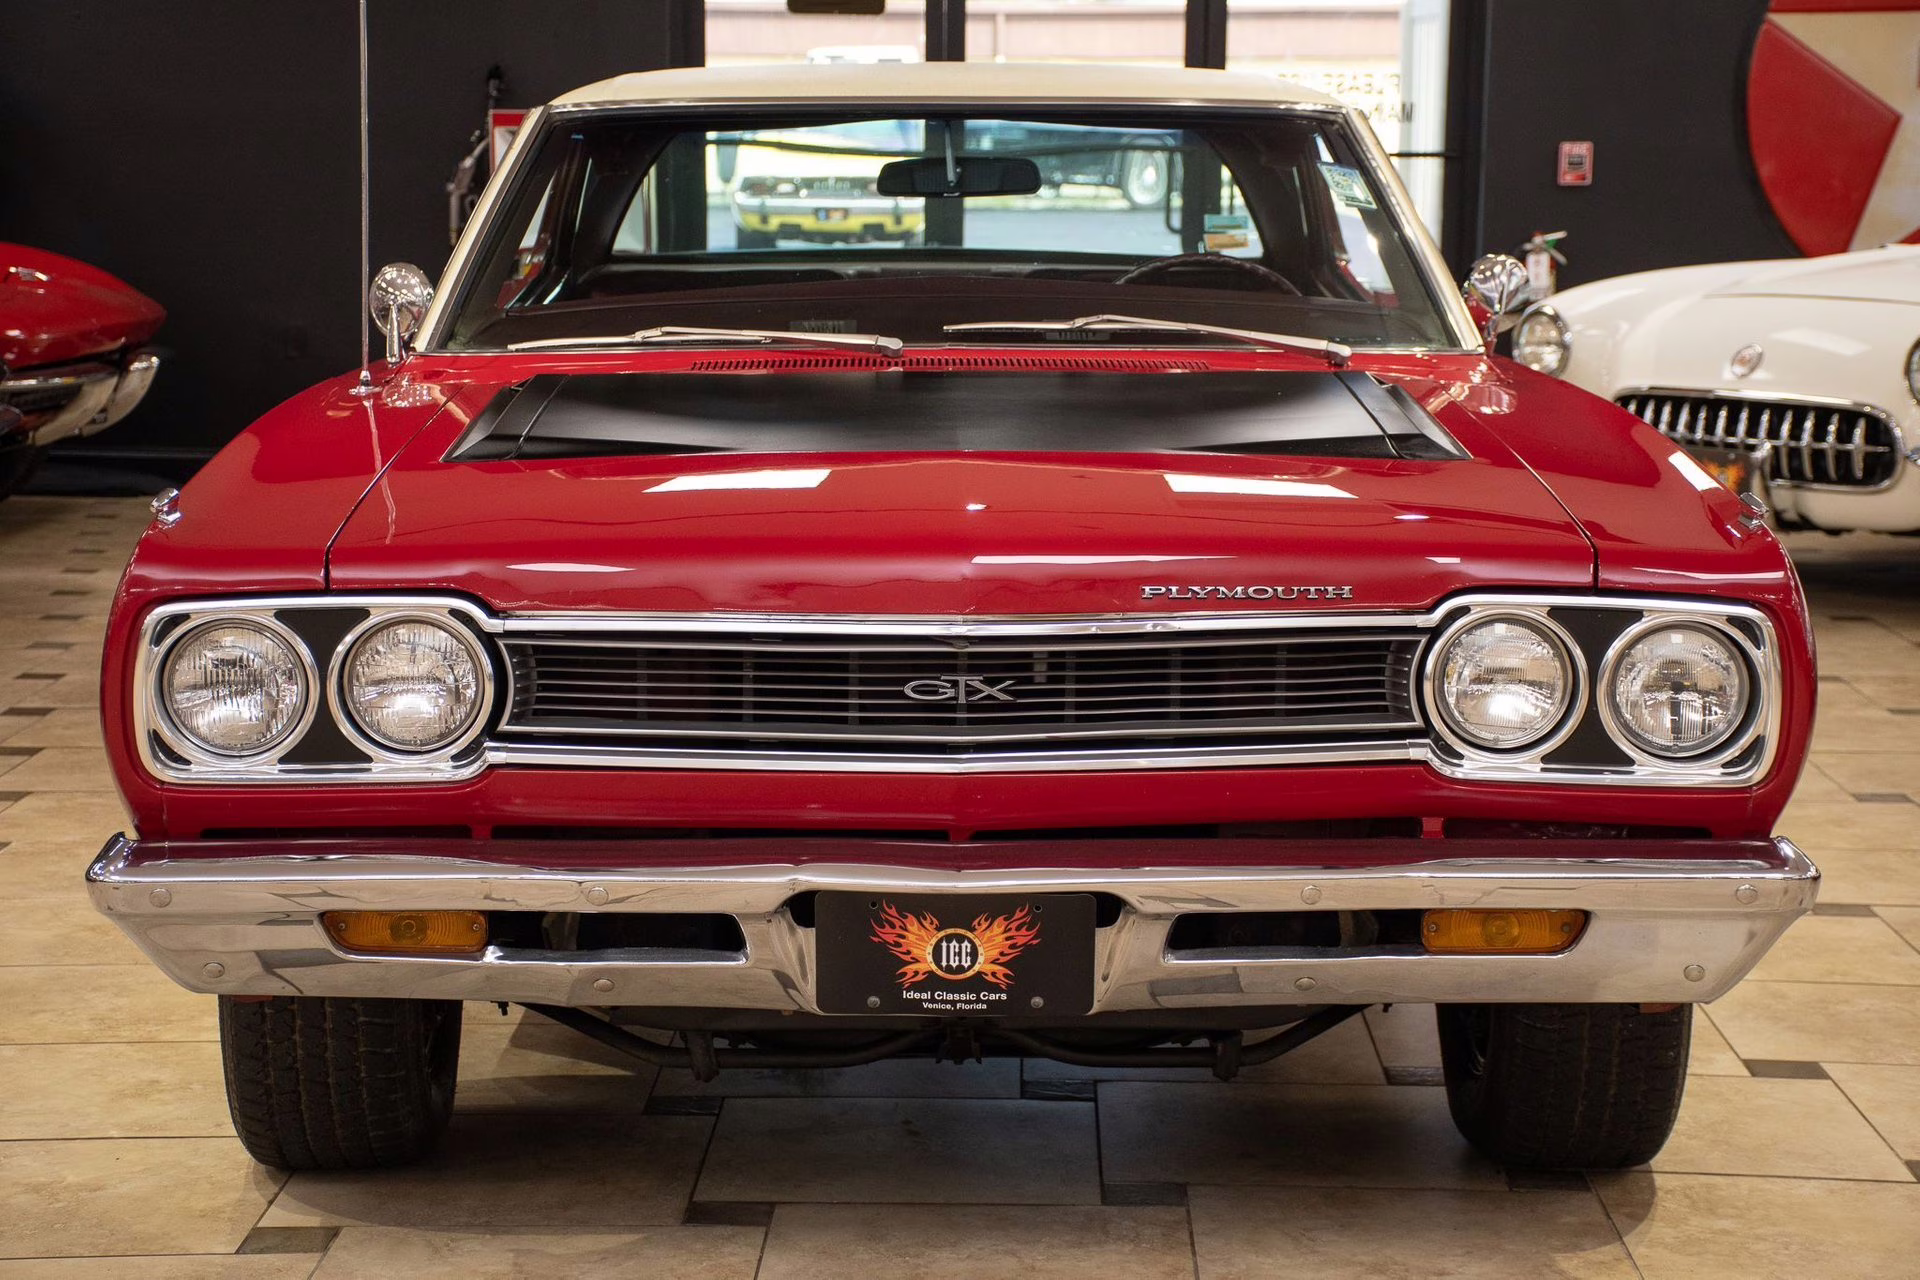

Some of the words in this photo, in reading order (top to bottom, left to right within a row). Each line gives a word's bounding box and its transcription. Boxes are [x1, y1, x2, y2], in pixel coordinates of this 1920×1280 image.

[1140, 585, 1354, 600] PLYMOUTH
[903, 675, 1015, 703] GTX
[941, 936, 972, 971] ICC
[902, 990, 931, 999] Ideal
[934, 991, 977, 1000] Classic
[980, 991, 1007, 1000] Cars
[922, 1002, 954, 1010] Venice,
